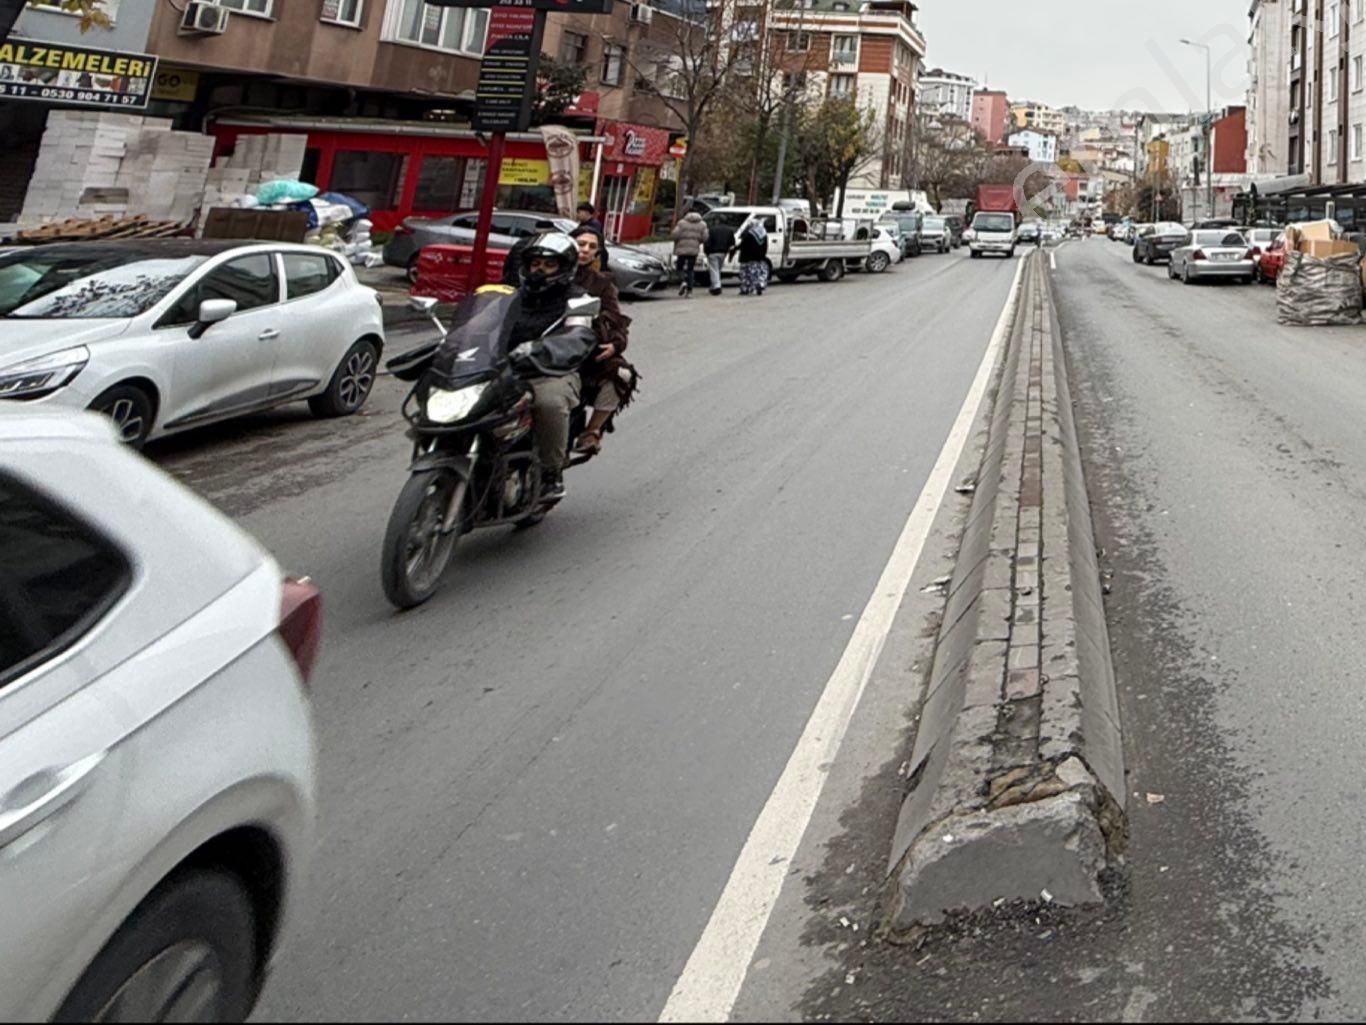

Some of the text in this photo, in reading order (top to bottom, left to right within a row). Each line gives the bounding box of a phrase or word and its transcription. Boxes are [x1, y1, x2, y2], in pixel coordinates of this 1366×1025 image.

[41, 87, 74, 99] 0530
[77, 90, 101, 101] 904
[104, 92, 118, 103] 71
[121, 94, 137, 105] 57
